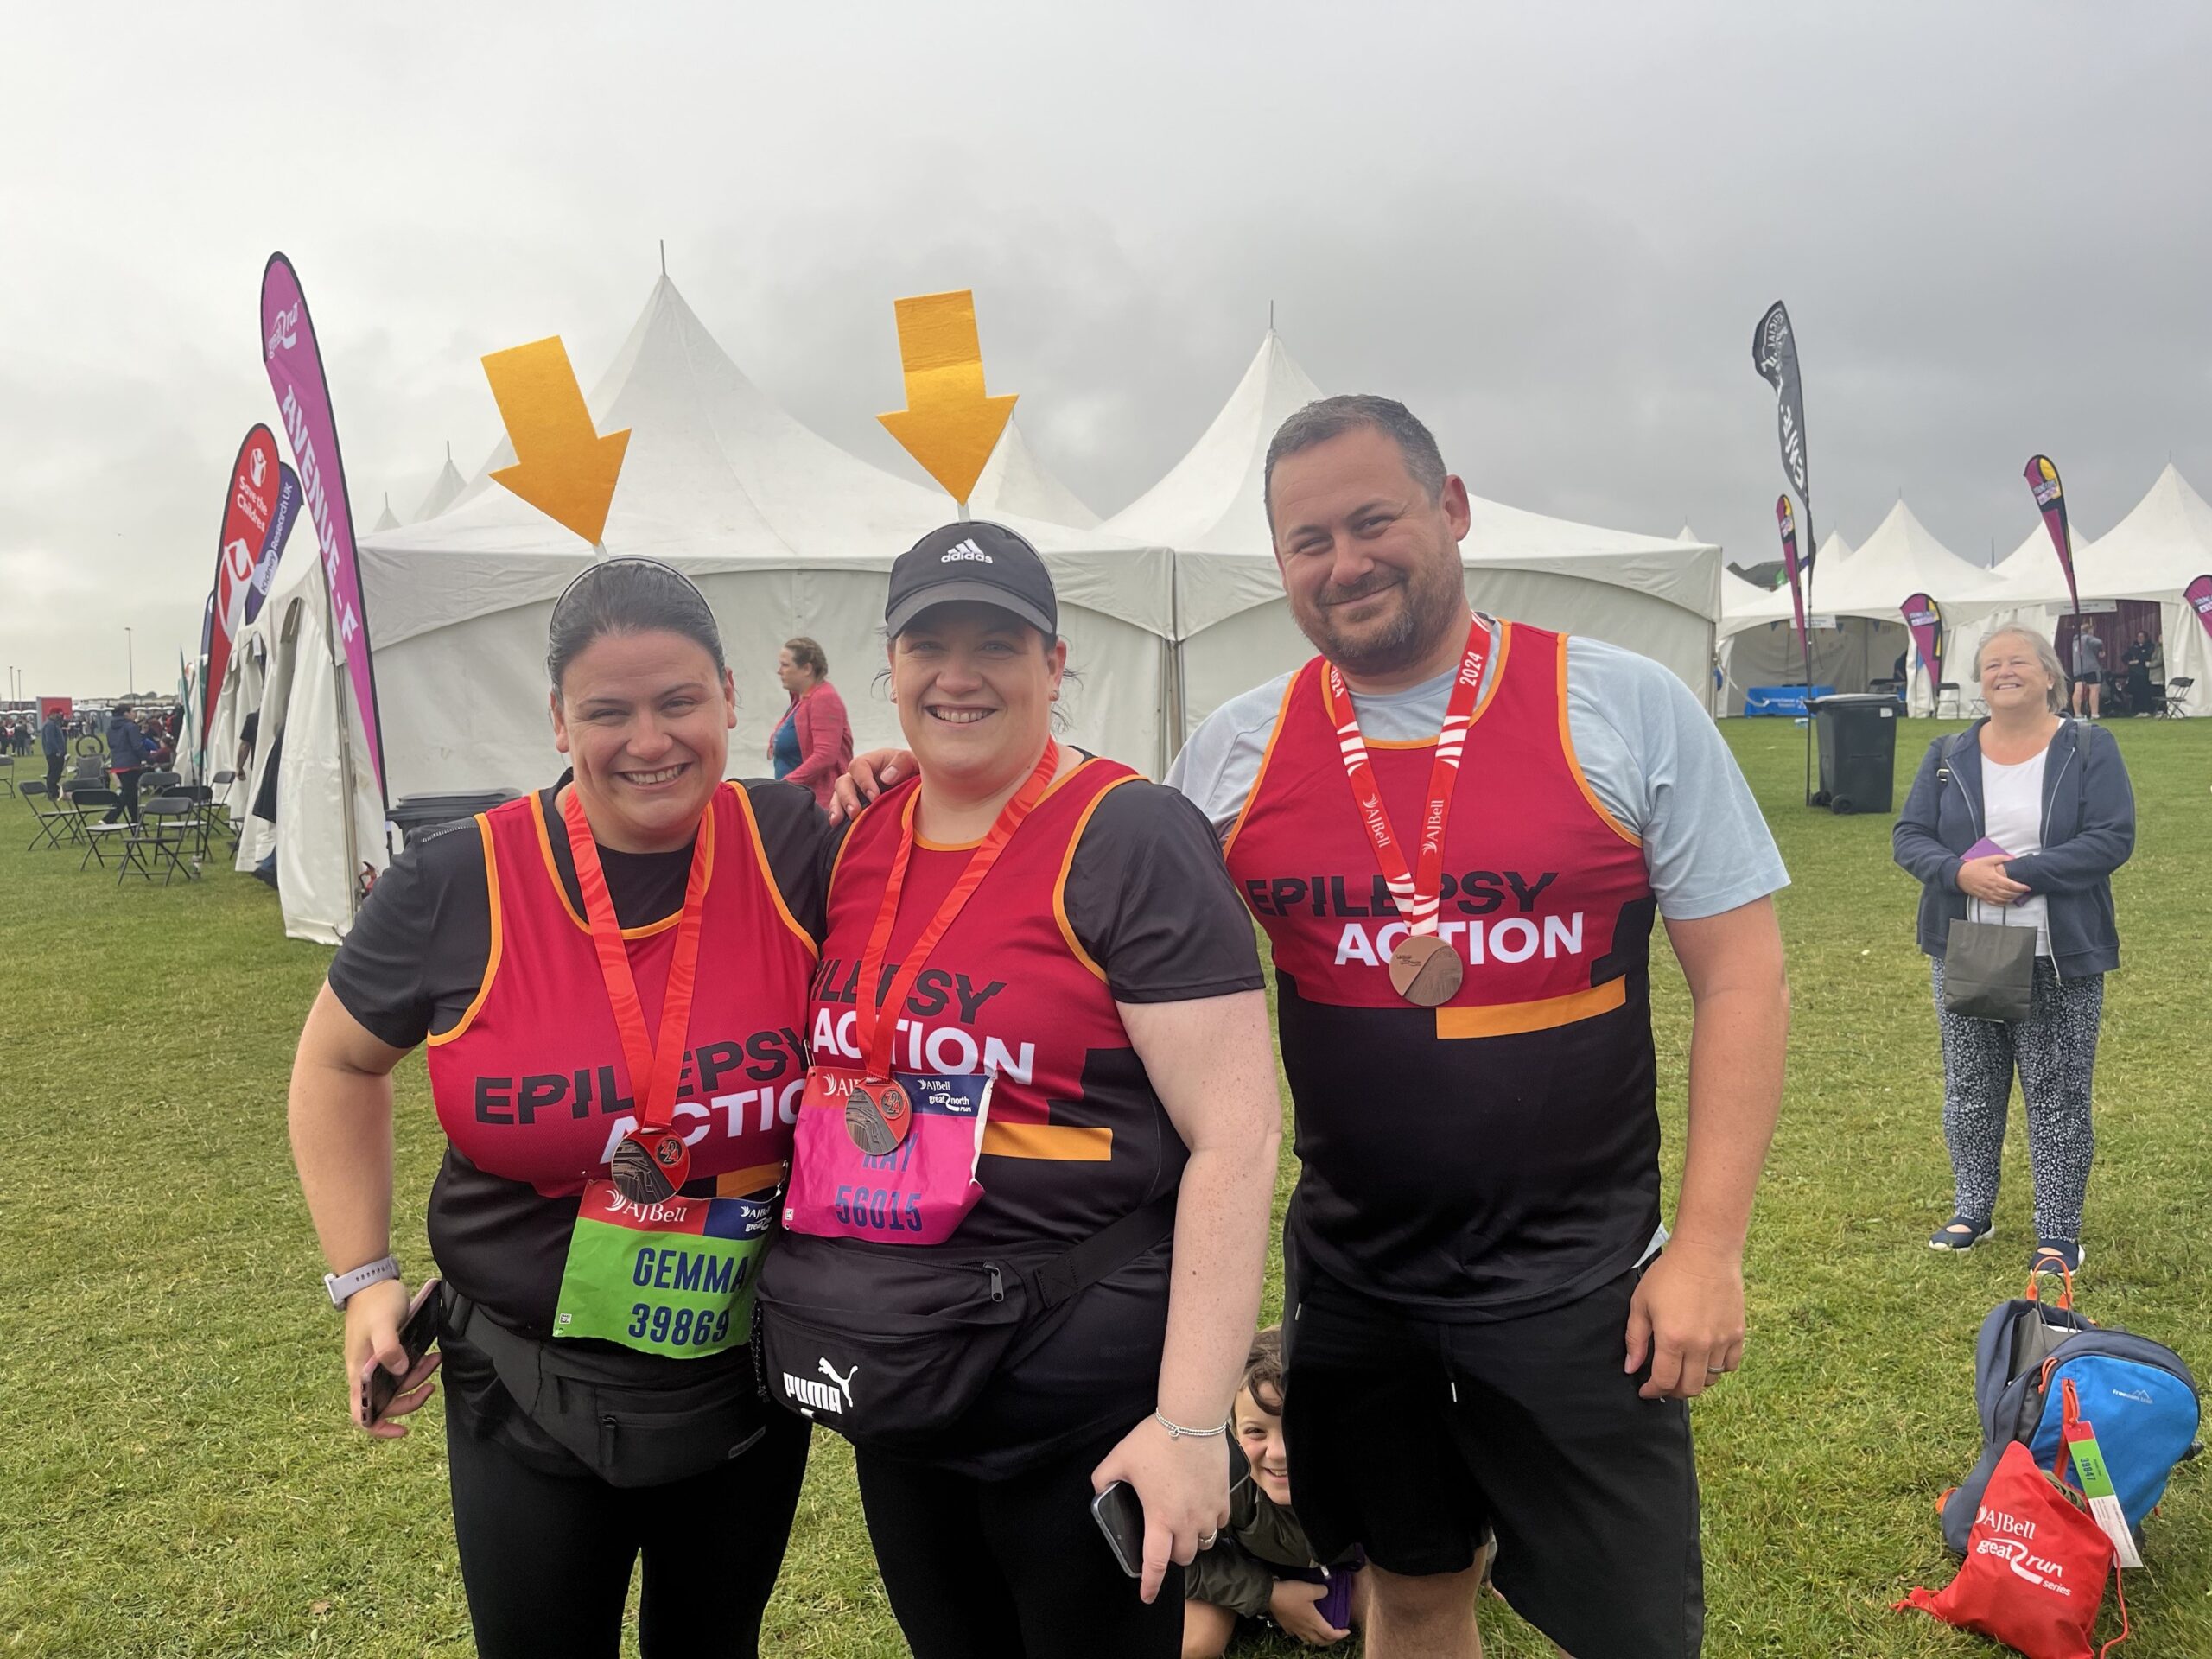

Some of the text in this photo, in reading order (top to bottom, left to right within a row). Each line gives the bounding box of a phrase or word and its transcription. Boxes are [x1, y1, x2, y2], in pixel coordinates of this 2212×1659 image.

[239, 475, 268, 516] Save the
[282, 384, 340, 591] AVENUE
[237, 493, 265, 532] Children
[262, 481, 293, 593] Kidney Research UK
[941, 551, 993, 564] adidas
[1459, 651, 1483, 687] 2024
[927, 1080, 950, 1091] AJBell
[929, 1094, 969, 1105] great north
[622, 1202, 688, 1223] AJBell
[836, 1185, 923, 1232] 56015
[632, 1247, 749, 1294] GEMMA
[628, 1303, 730, 1346] 39869
[783, 1371, 842, 1414] PUMA
[1983, 1510, 2036, 1540] AJBell
[1977, 1540, 2063, 1578] great run
[2043, 1580, 2072, 1597] series
